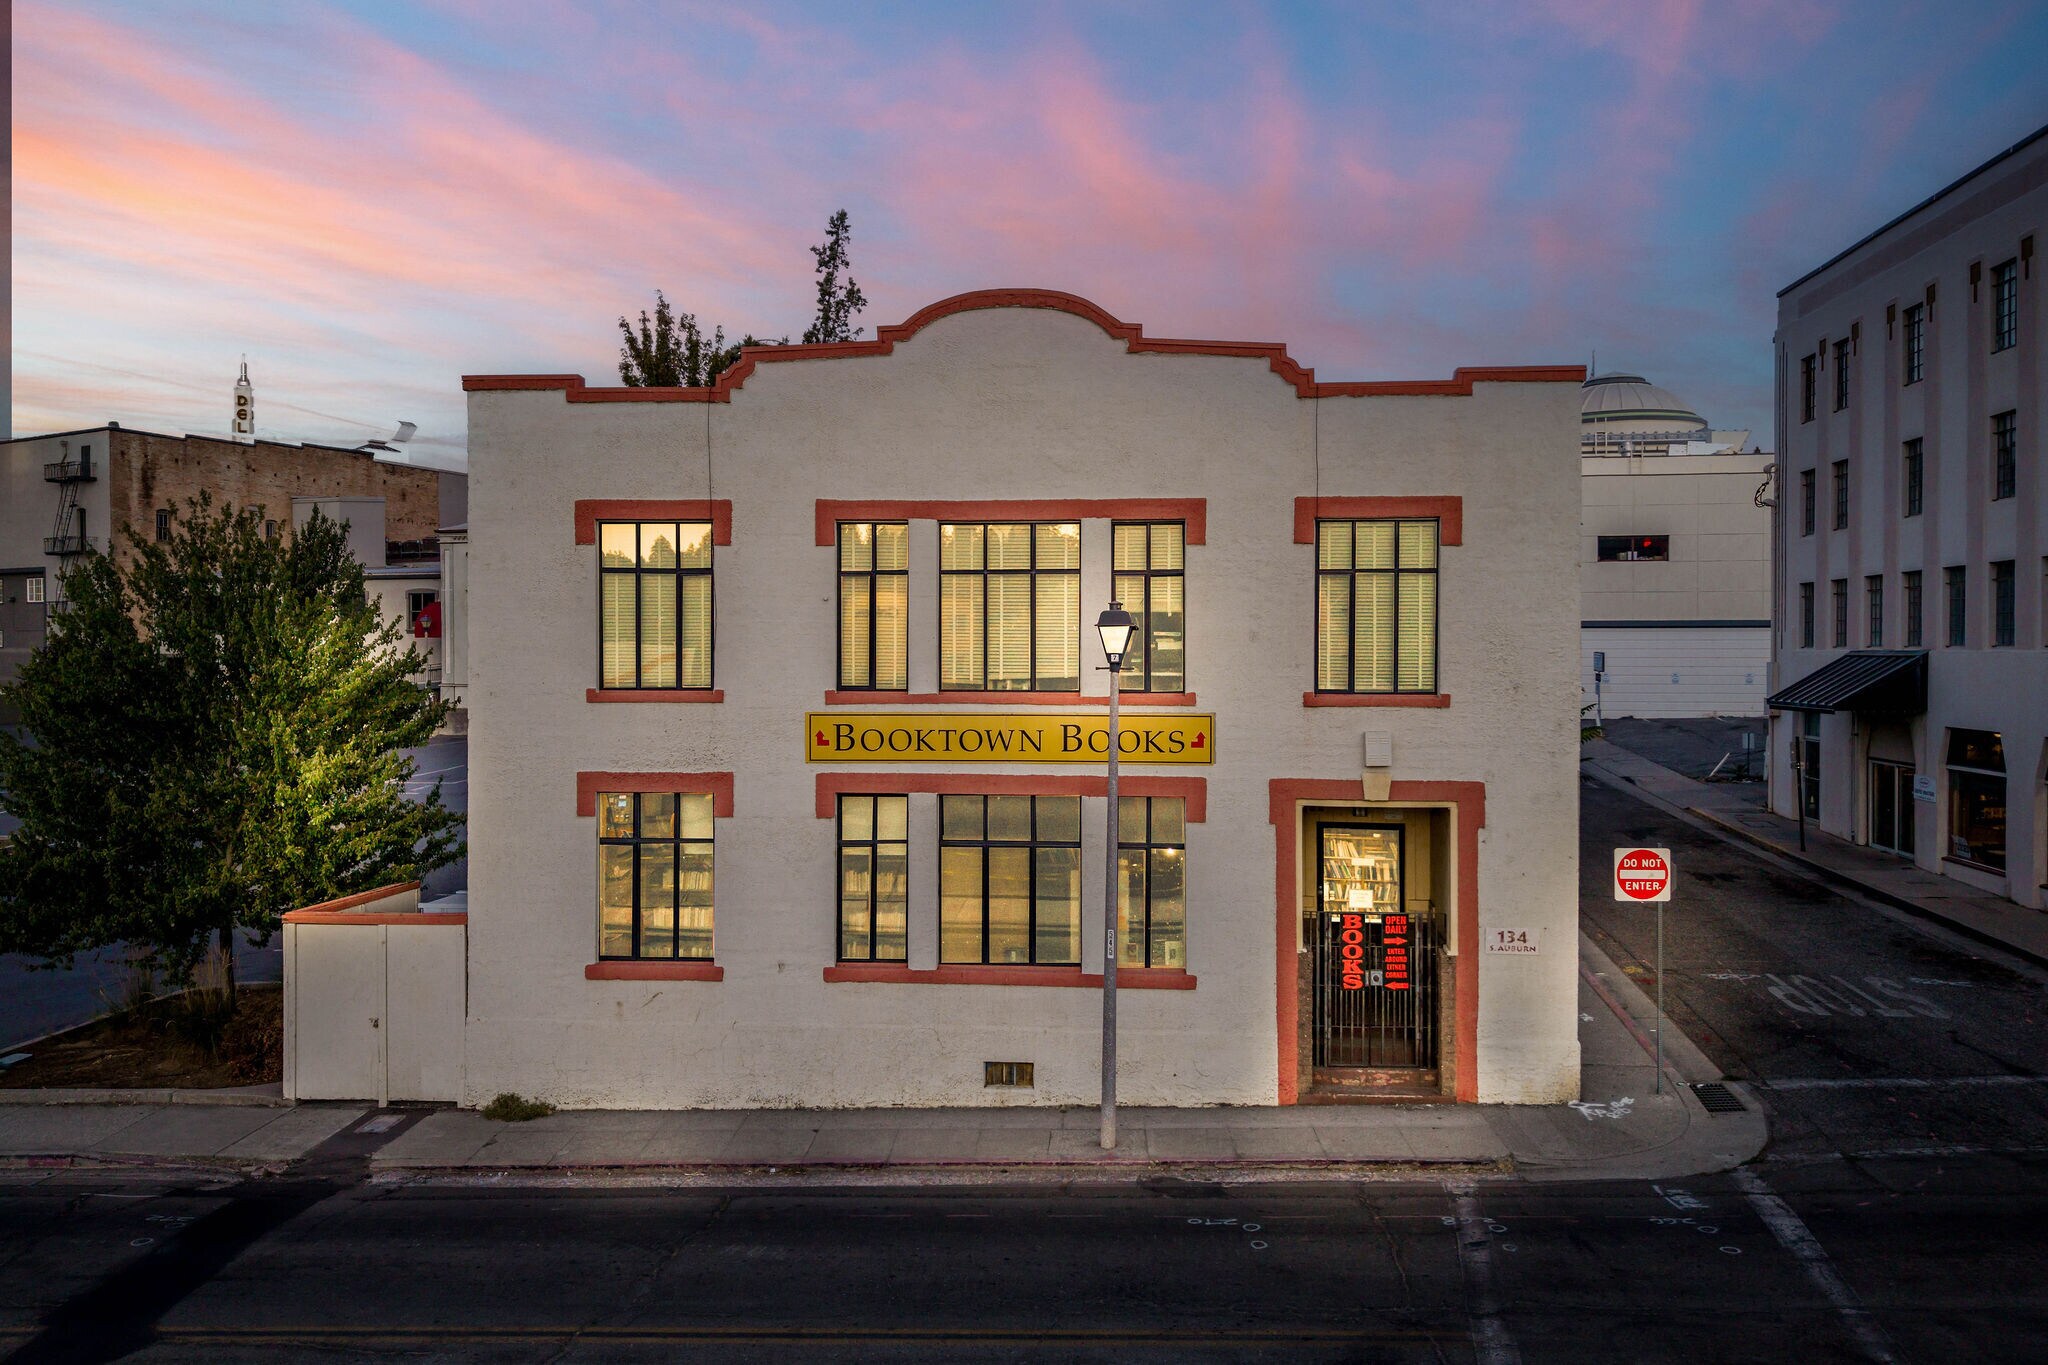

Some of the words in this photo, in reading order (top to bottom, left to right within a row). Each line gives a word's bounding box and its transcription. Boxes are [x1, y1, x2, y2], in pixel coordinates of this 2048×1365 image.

[237, 394, 248, 433] DEL
[1623, 858, 1638, 868] DO
[1641, 858, 1662, 868] NOT
[1625, 881, 1660, 890] ENTER
[1385, 915, 1407, 925] OPEN
[1385, 925, 1407, 934] DAILY
[1497, 930, 1527, 944] 134
[1341, 914, 1364, 990] BOOKS
